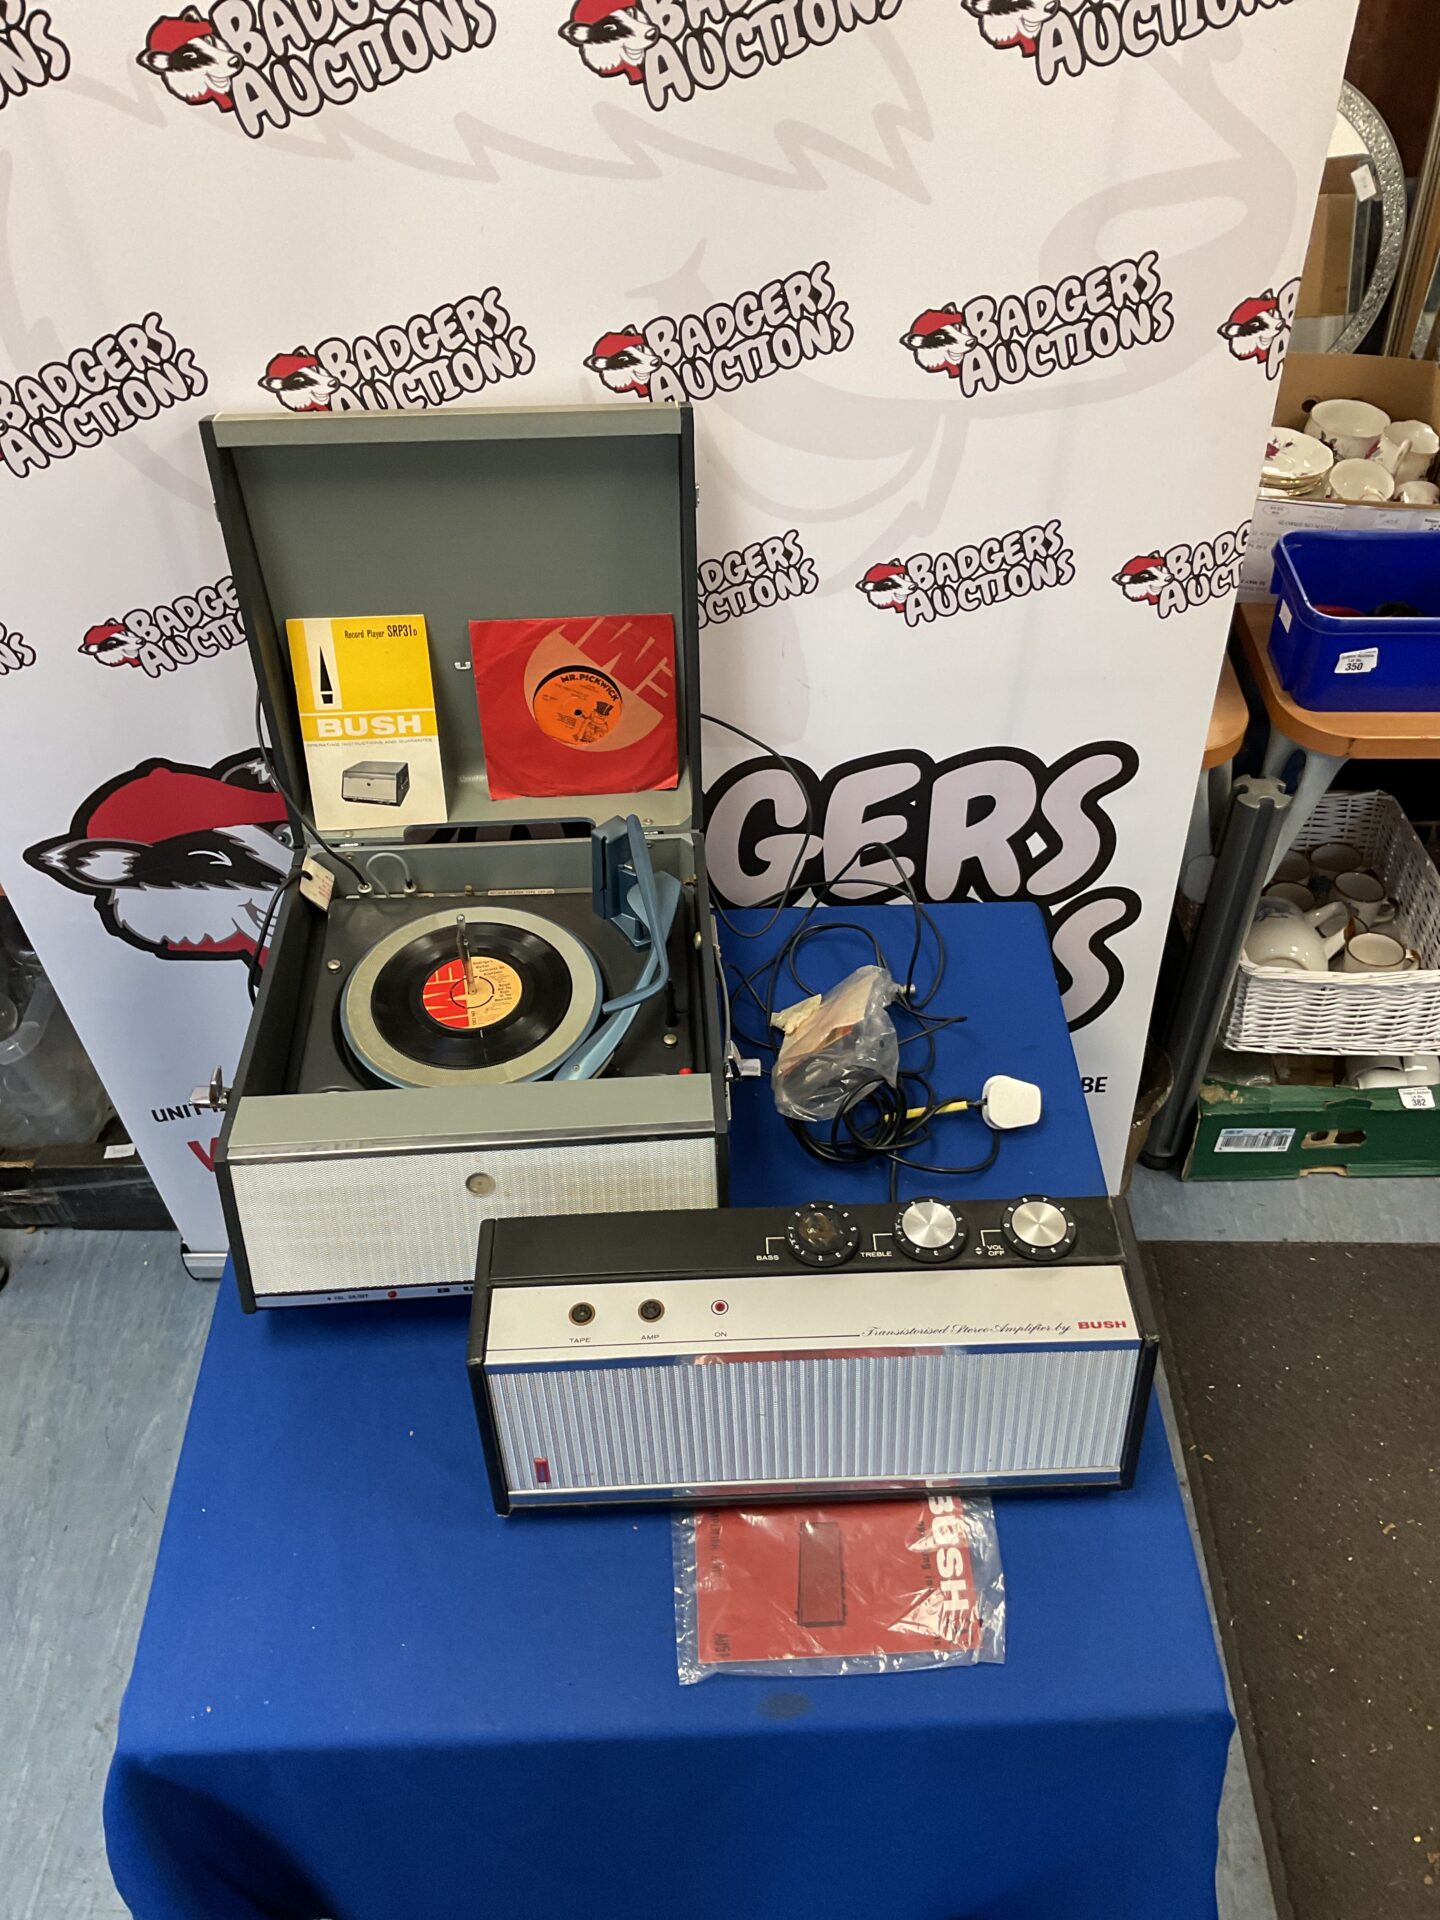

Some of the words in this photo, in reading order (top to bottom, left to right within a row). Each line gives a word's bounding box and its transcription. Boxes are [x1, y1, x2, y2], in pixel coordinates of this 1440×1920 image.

[642, 260, 835, 367] BADGERS
[962, 250, 1161, 350] BADGERS
[314, 286, 511, 388] BADGERS
[649, 301, 855, 403] AUCTIONS
[959, 291, 1175, 399] AUCTIONS
[0, 348, 209, 479] AUCTIONS
[697, 529, 804, 597] DGERS
[904, 519, 1064, 589] BADGERS
[122, 575, 240, 643] BADGE
[697, 558, 819, 630] CTIONS
[904, 549, 1076, 628] AUCTIONS
[138, 612, 248, 679] AUCTI
[344, 630, 364, 639] Record
[367, 629, 384, 640] Player
[1345, 662, 1364, 672] 350
[579, 673, 619, 702] PICKWICK
[316, 715, 421, 738] BUSH
[702, 740, 1140, 908] GERS
[1412, 1098, 1426, 1106] 382
[860, 1250, 893, 1258] TREBLE
[861, 1324, 950, 1337] Transistorised
[950, 1324, 989, 1335] Stereo
[988, 1322, 1052, 1335] Amplifier
[1054, 1322, 1072, 1335] by
[1077, 1320, 1128, 1330] BUSH
